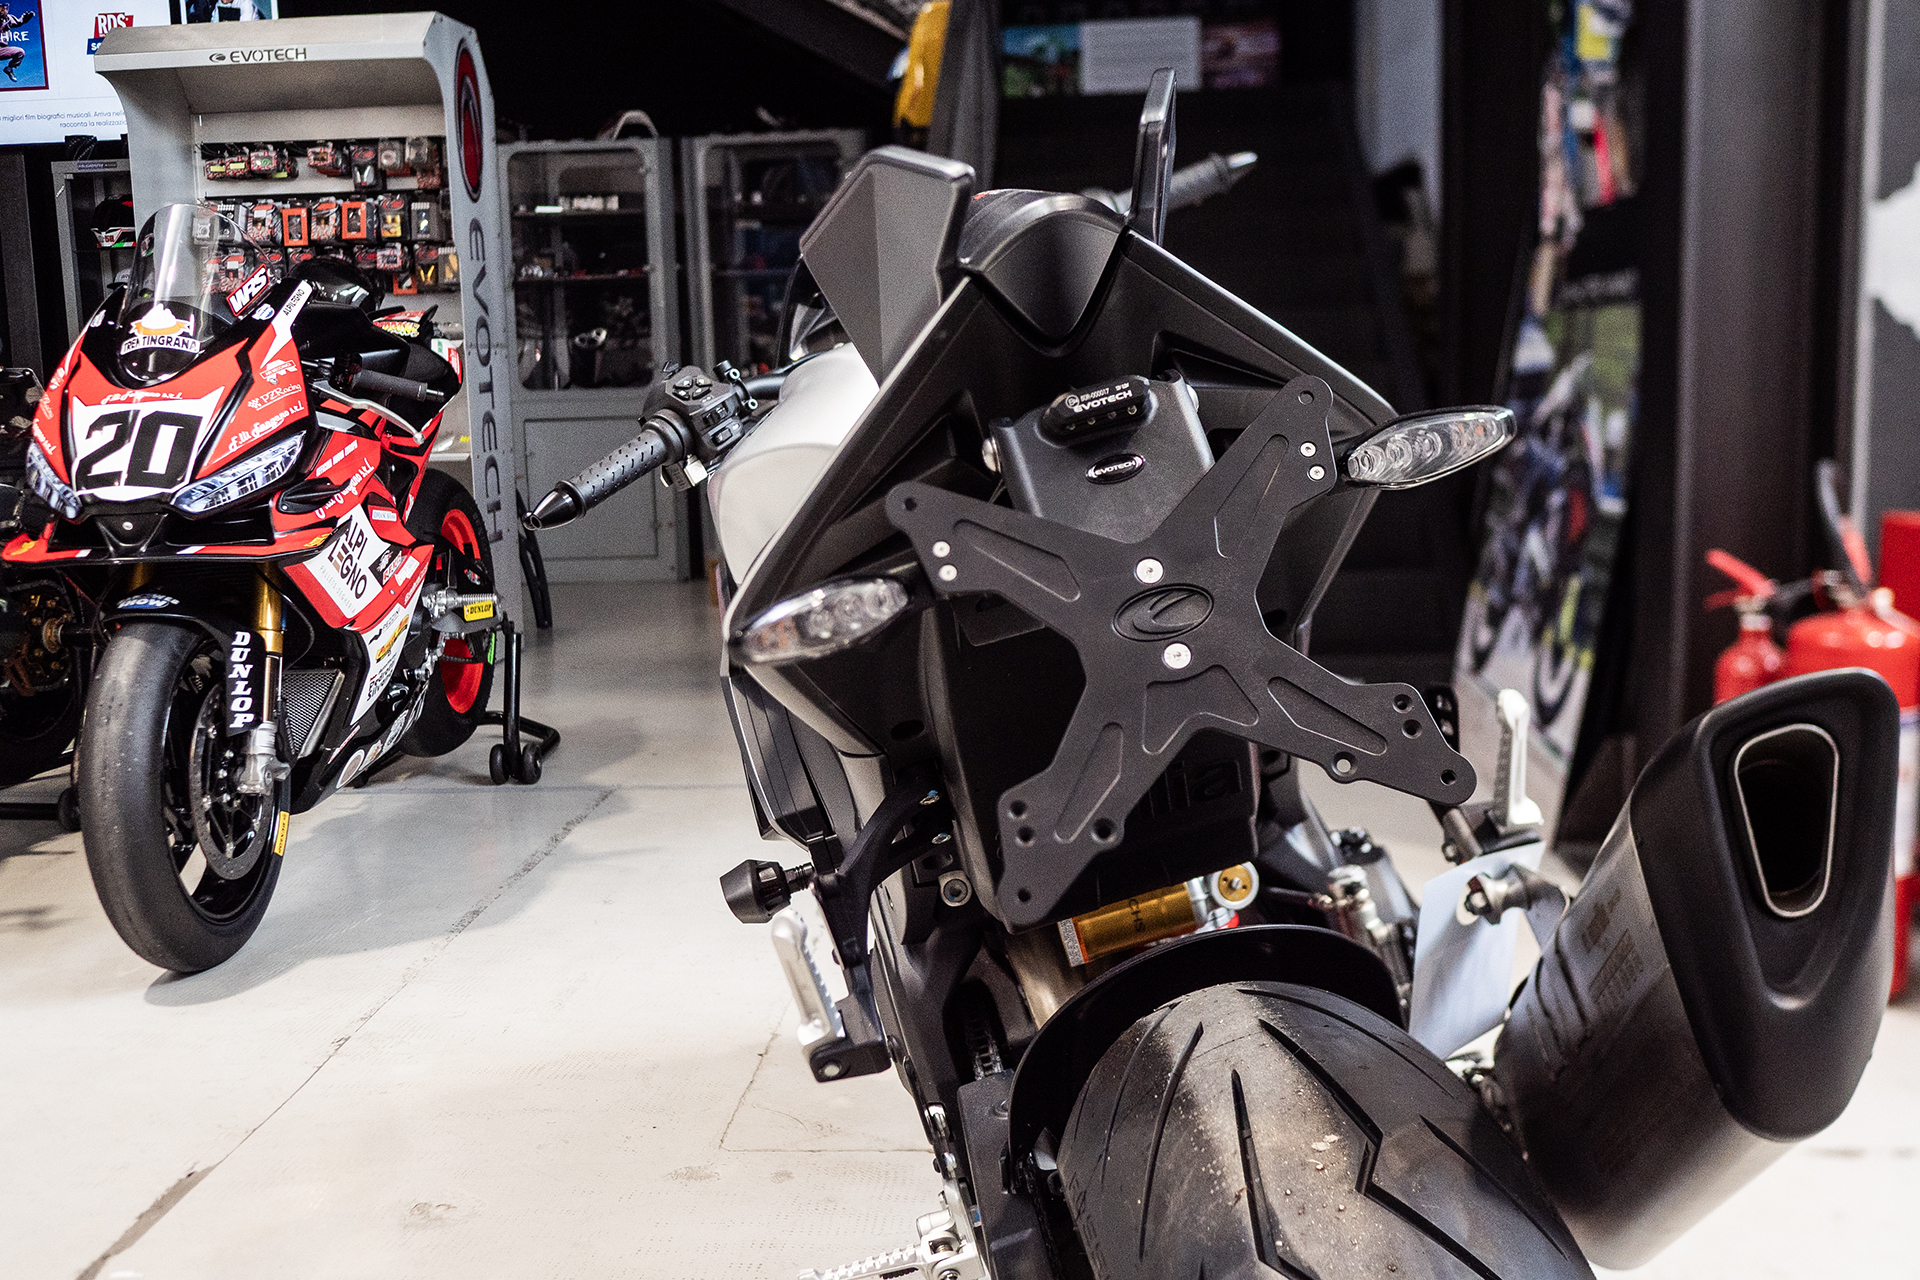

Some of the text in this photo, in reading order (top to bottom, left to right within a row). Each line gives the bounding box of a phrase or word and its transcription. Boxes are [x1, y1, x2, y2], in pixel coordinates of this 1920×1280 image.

[229, 47, 307, 63] EVOTECH
[37, 113, 65, 121] biografici
[229, 267, 269, 312] WRS
[469, 218, 503, 543] EVOTECH
[261, 384, 302, 403] PZRacing
[1073, 390, 1133, 413] EVOTECH
[76, 409, 203, 490] 20
[1095, 460, 1136, 476] EVOTECH
[470, 603, 492, 615] DUNLOP
[228, 631, 254, 728] DUNLOP
